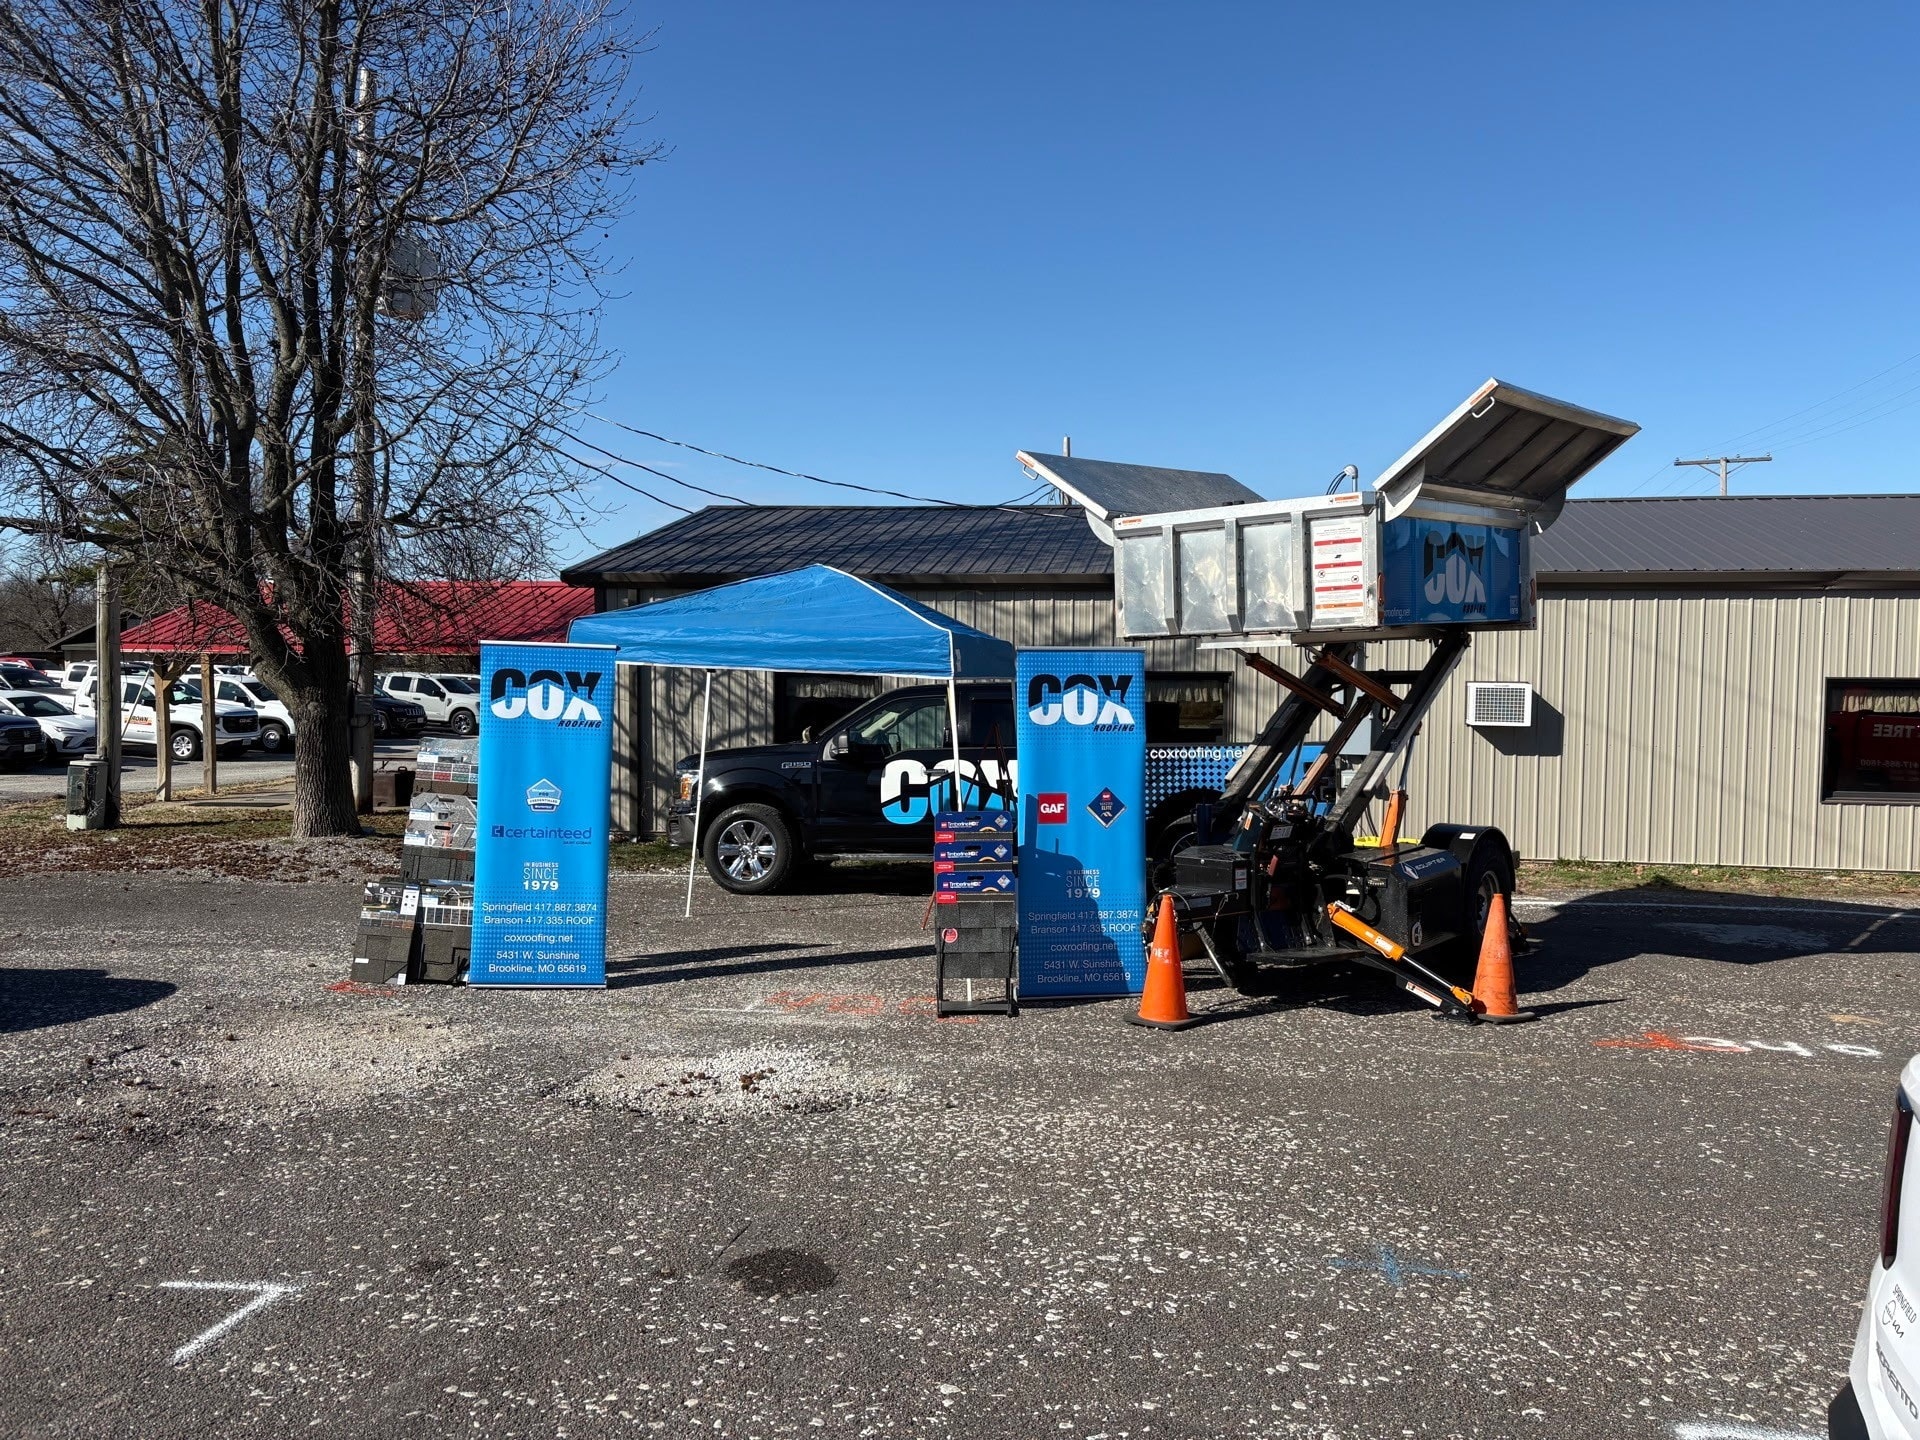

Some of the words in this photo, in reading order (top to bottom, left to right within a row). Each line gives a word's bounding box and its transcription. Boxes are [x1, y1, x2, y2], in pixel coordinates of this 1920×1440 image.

[1424, 531, 1487, 604] COX
[490, 668, 602, 720] COX
[1028, 674, 1136, 726] COX
[558, 720, 602, 728] ROOFING
[1040, 803, 1065, 814] GAF
[505, 826, 592, 840] certainteed
[523, 868, 558, 880] SINCE
[523, 881, 559, 890] 1979
[1066, 876, 1100, 887] SINCE
[1066, 888, 1100, 898] 1979
[482, 903, 532, 912] Springfield
[534, 904, 597, 912] 417.887.3874
[1028, 912, 1076, 922] Springfield
[1078, 910, 1138, 920] 417.887.3874
[1031, 926, 1068, 934] Branson
[1070, 924, 1137, 933] 417.335.ROOF
[504, 934, 574, 944] coxroofing.net
[1051, 942, 1116, 952] coxroofing.net
[496, 952, 518, 960] 5431
[537, 952, 580, 960] Sunshine
[489, 964, 534, 974] Brookline,
[538, 964, 554, 972] MO
[558, 964, 587, 972] 65619
[1044, 962, 1066, 970] 5431
[1083, 960, 1124, 969] Sunshine
[1038, 974, 1082, 984] Brookline,
[1085, 974, 1100, 982] MO
[1103, 973, 1131, 982] 65619
[1892, 1284, 1917, 1324] SPRINGFIELD
[1876, 1340, 1918, 1420] SORENTO
